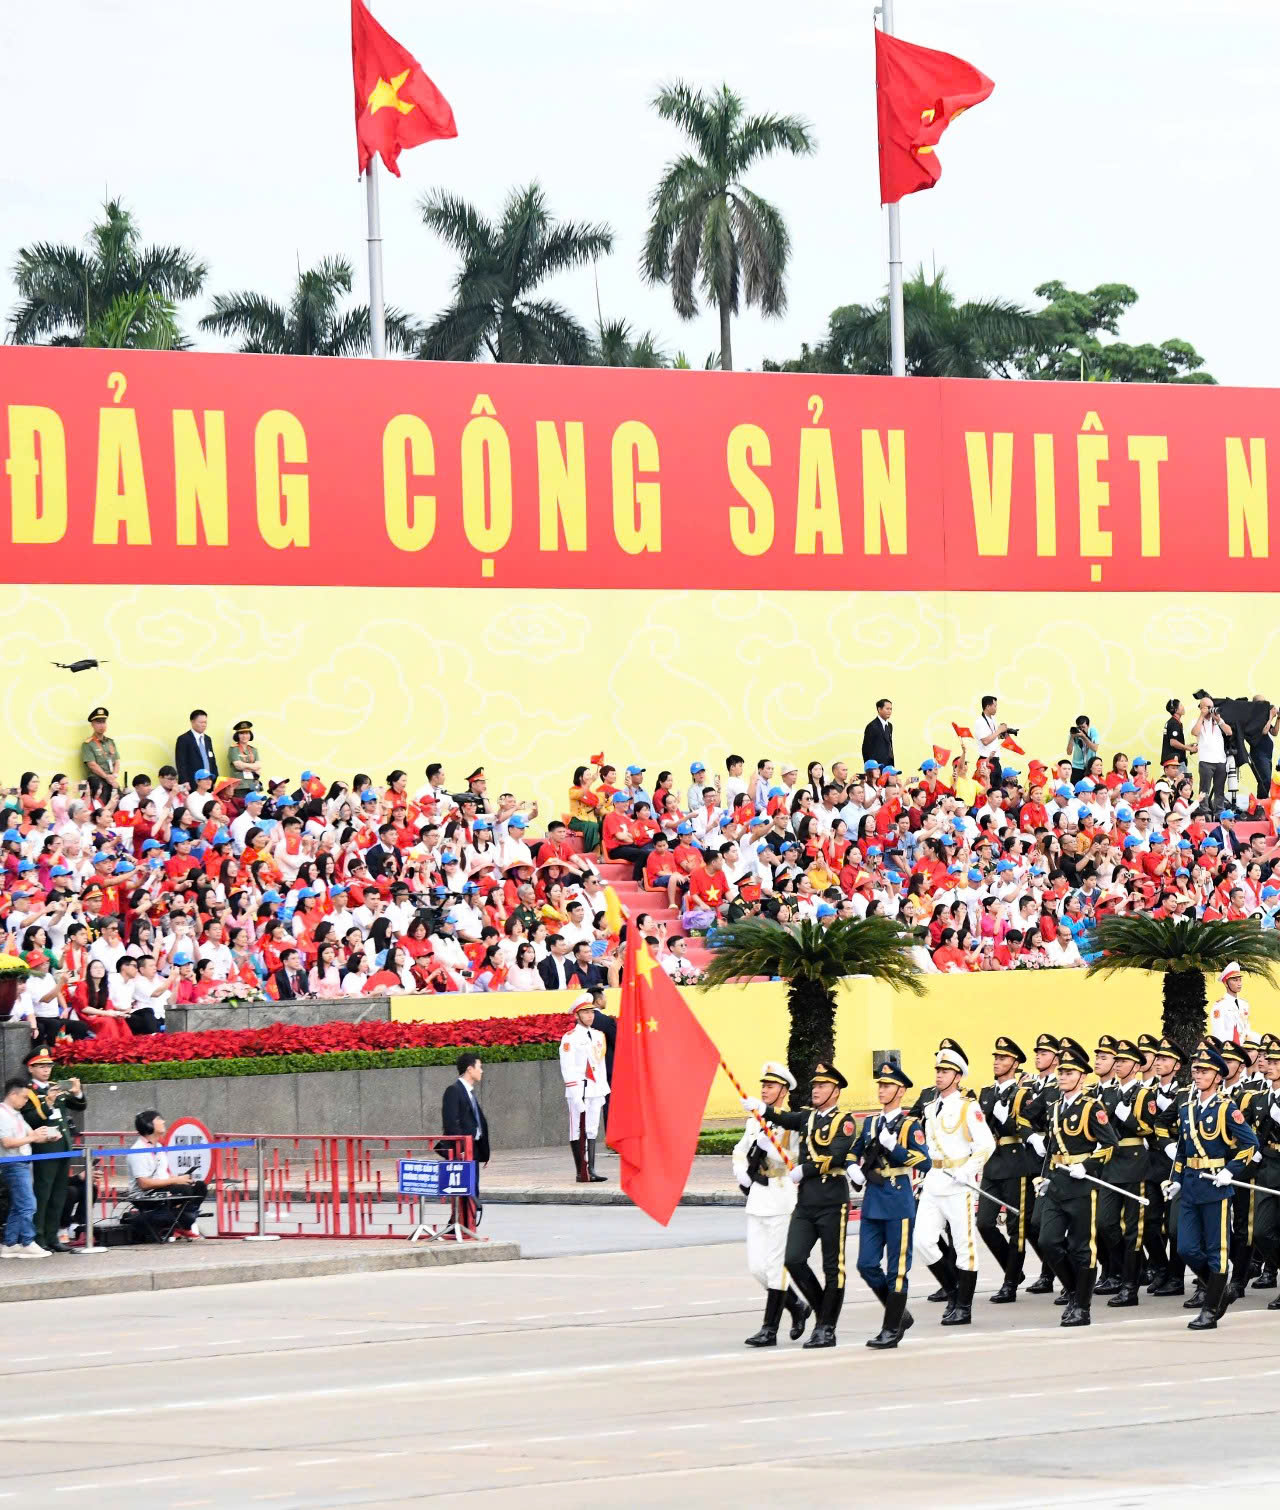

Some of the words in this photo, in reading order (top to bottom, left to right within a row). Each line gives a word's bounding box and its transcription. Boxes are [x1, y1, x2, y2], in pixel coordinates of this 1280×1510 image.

[6, 372, 310, 549] ĐẢNG
[383, 394, 661, 577] CỘNG
[727, 395, 908, 556] SẢN
[965, 411, 1169, 582] VIỆT
[449, 1172, 461, 1186] A1
